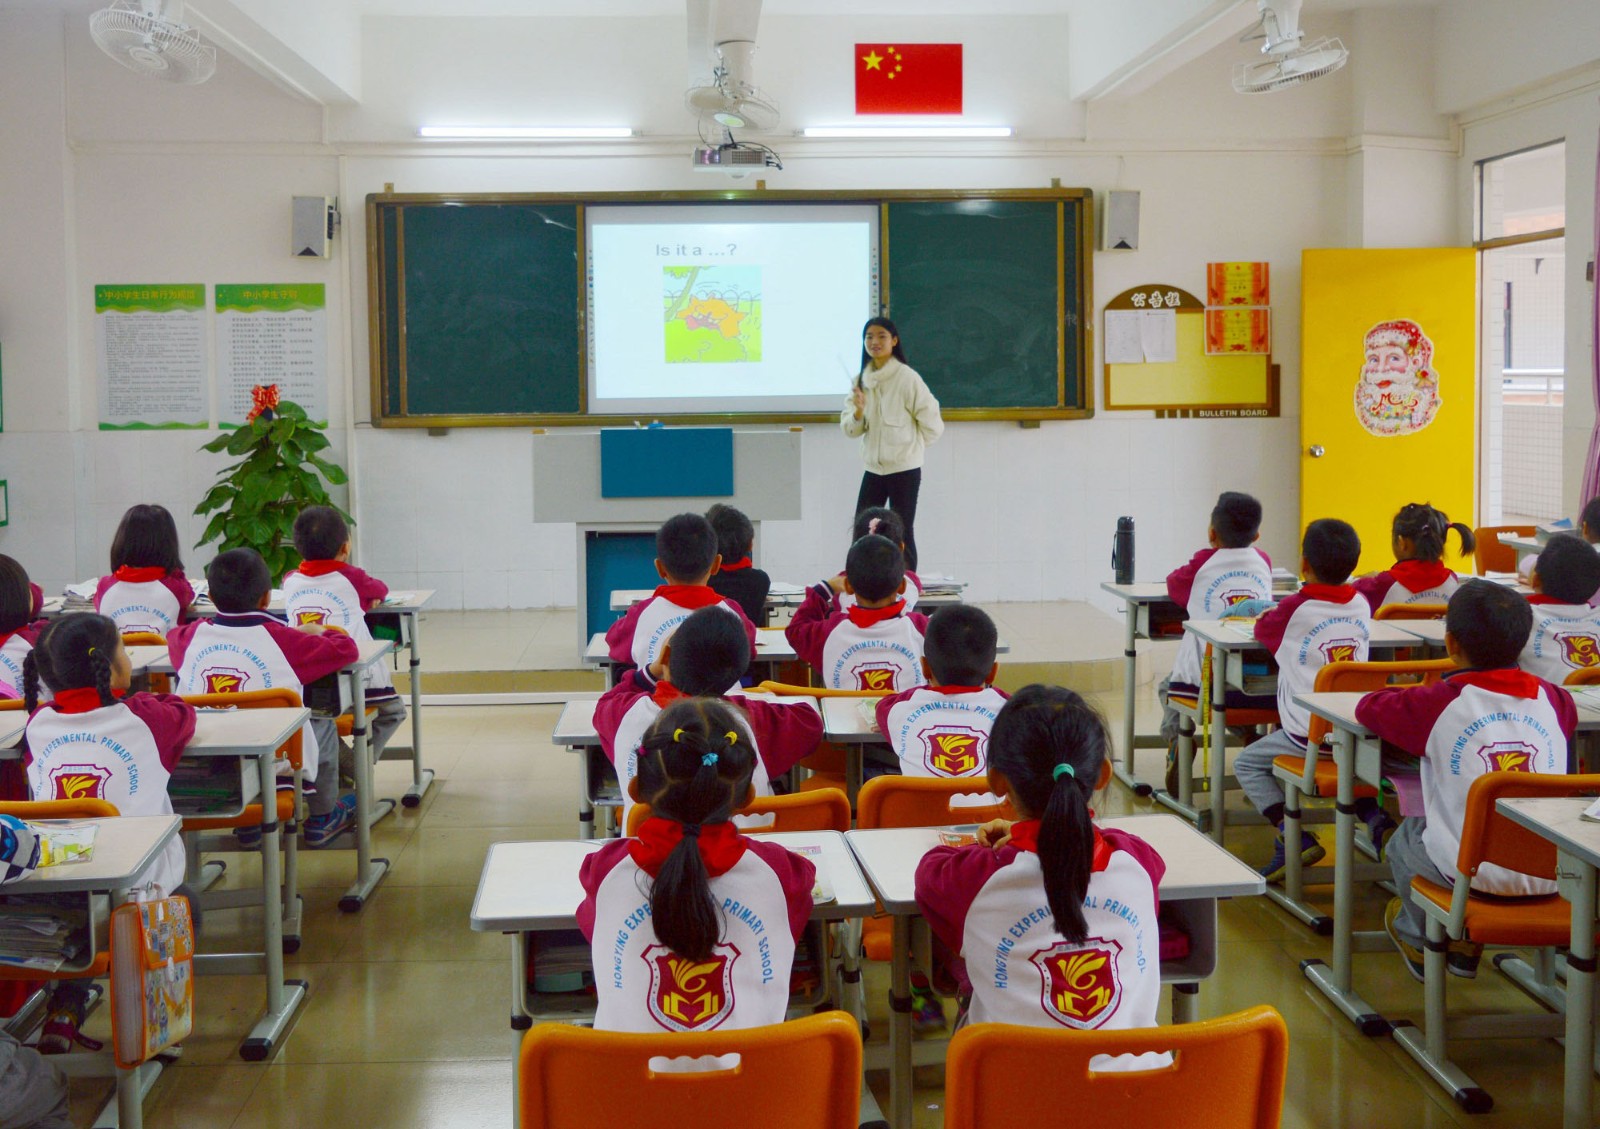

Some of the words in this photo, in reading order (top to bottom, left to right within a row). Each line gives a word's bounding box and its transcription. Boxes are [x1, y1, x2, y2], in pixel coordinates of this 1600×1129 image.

[656, 244, 670, 256] Is
[677, 244, 686, 256] it
[692, 246, 702, 256] a
[1199, 409, 1237, 417] BULLETIN
[1240, 408, 1268, 416] BOARD
[647, 635, 659, 664] ONGYING
[262, 671, 273, 689] SCHO
[907, 701, 971, 723] EXPERIMENTAL
[974, 705, 997, 720] PRIM
[1450, 735, 1468, 776] HONGYING
[1464, 712, 1520, 737] EXPERIMENTAL
[42, 733, 97, 758] EXPERIMENTAL
[100, 736, 133, 763] PRIMARY
[127, 763, 138, 796] SCHOOL
[614, 929, 629, 989] HONGYING
[722, 897, 765, 935] PRIMARY
[758, 936, 774, 984] SCHOOL
[994, 936, 1015, 989] HONGYING
